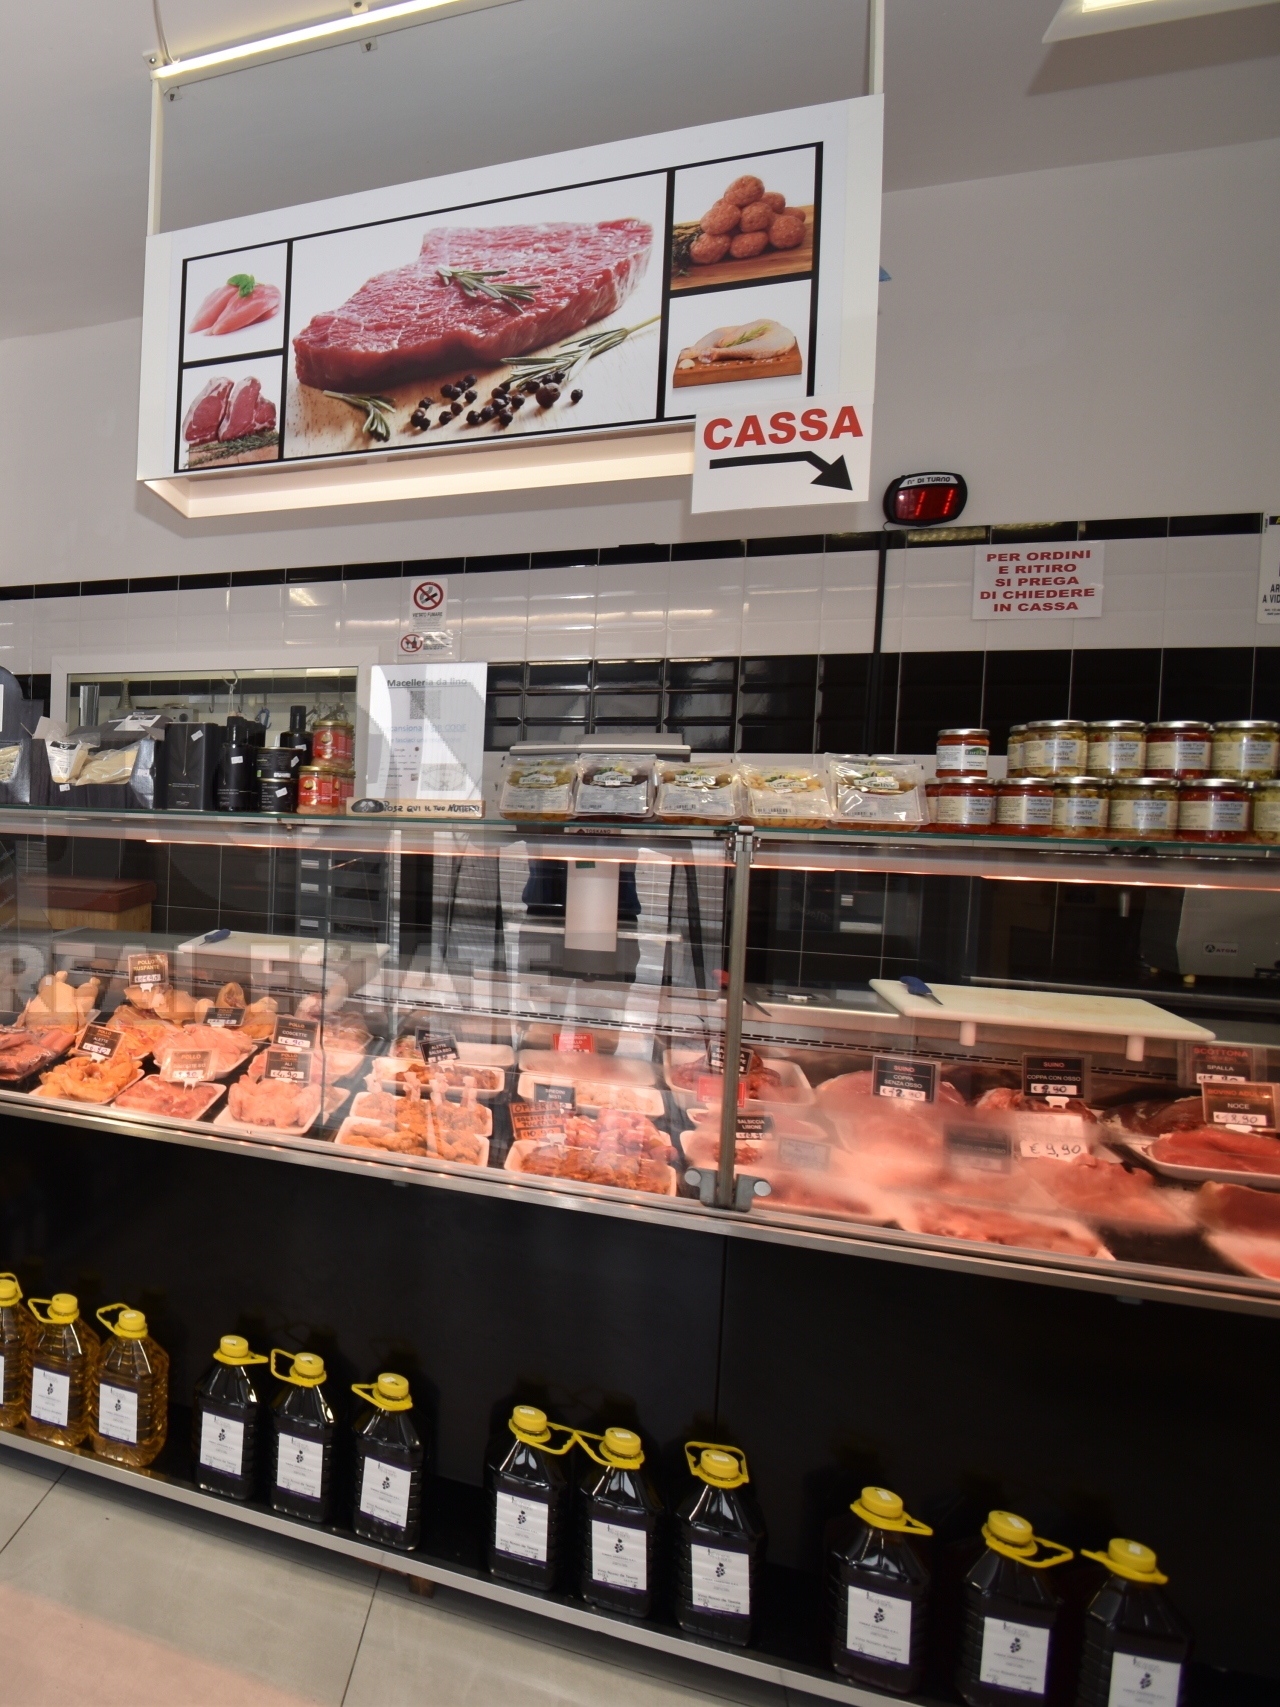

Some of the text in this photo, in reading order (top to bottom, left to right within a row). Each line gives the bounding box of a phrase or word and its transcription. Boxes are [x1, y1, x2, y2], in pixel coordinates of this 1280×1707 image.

[703, 405, 864, 450] CASSA
[986, 550, 1091, 562] PER ORDINI
[998, 563, 1077, 574] E RITIRO
[995, 576, 1079, 587] SI PREGA
[980, 588, 1095, 600] DI CHIEDERE
[993, 602, 1079, 612] IN CASSA
[387, 678, 433, 687] Macelleria
[436, 678, 447, 686] da
[1193, 1047, 1249, 1057] SCOTTONA
[893, 1065, 915, 1073] SUINO
[514, 1102, 558, 1113] OFFERTA
[1030, 1142, 1040, 1154] €
